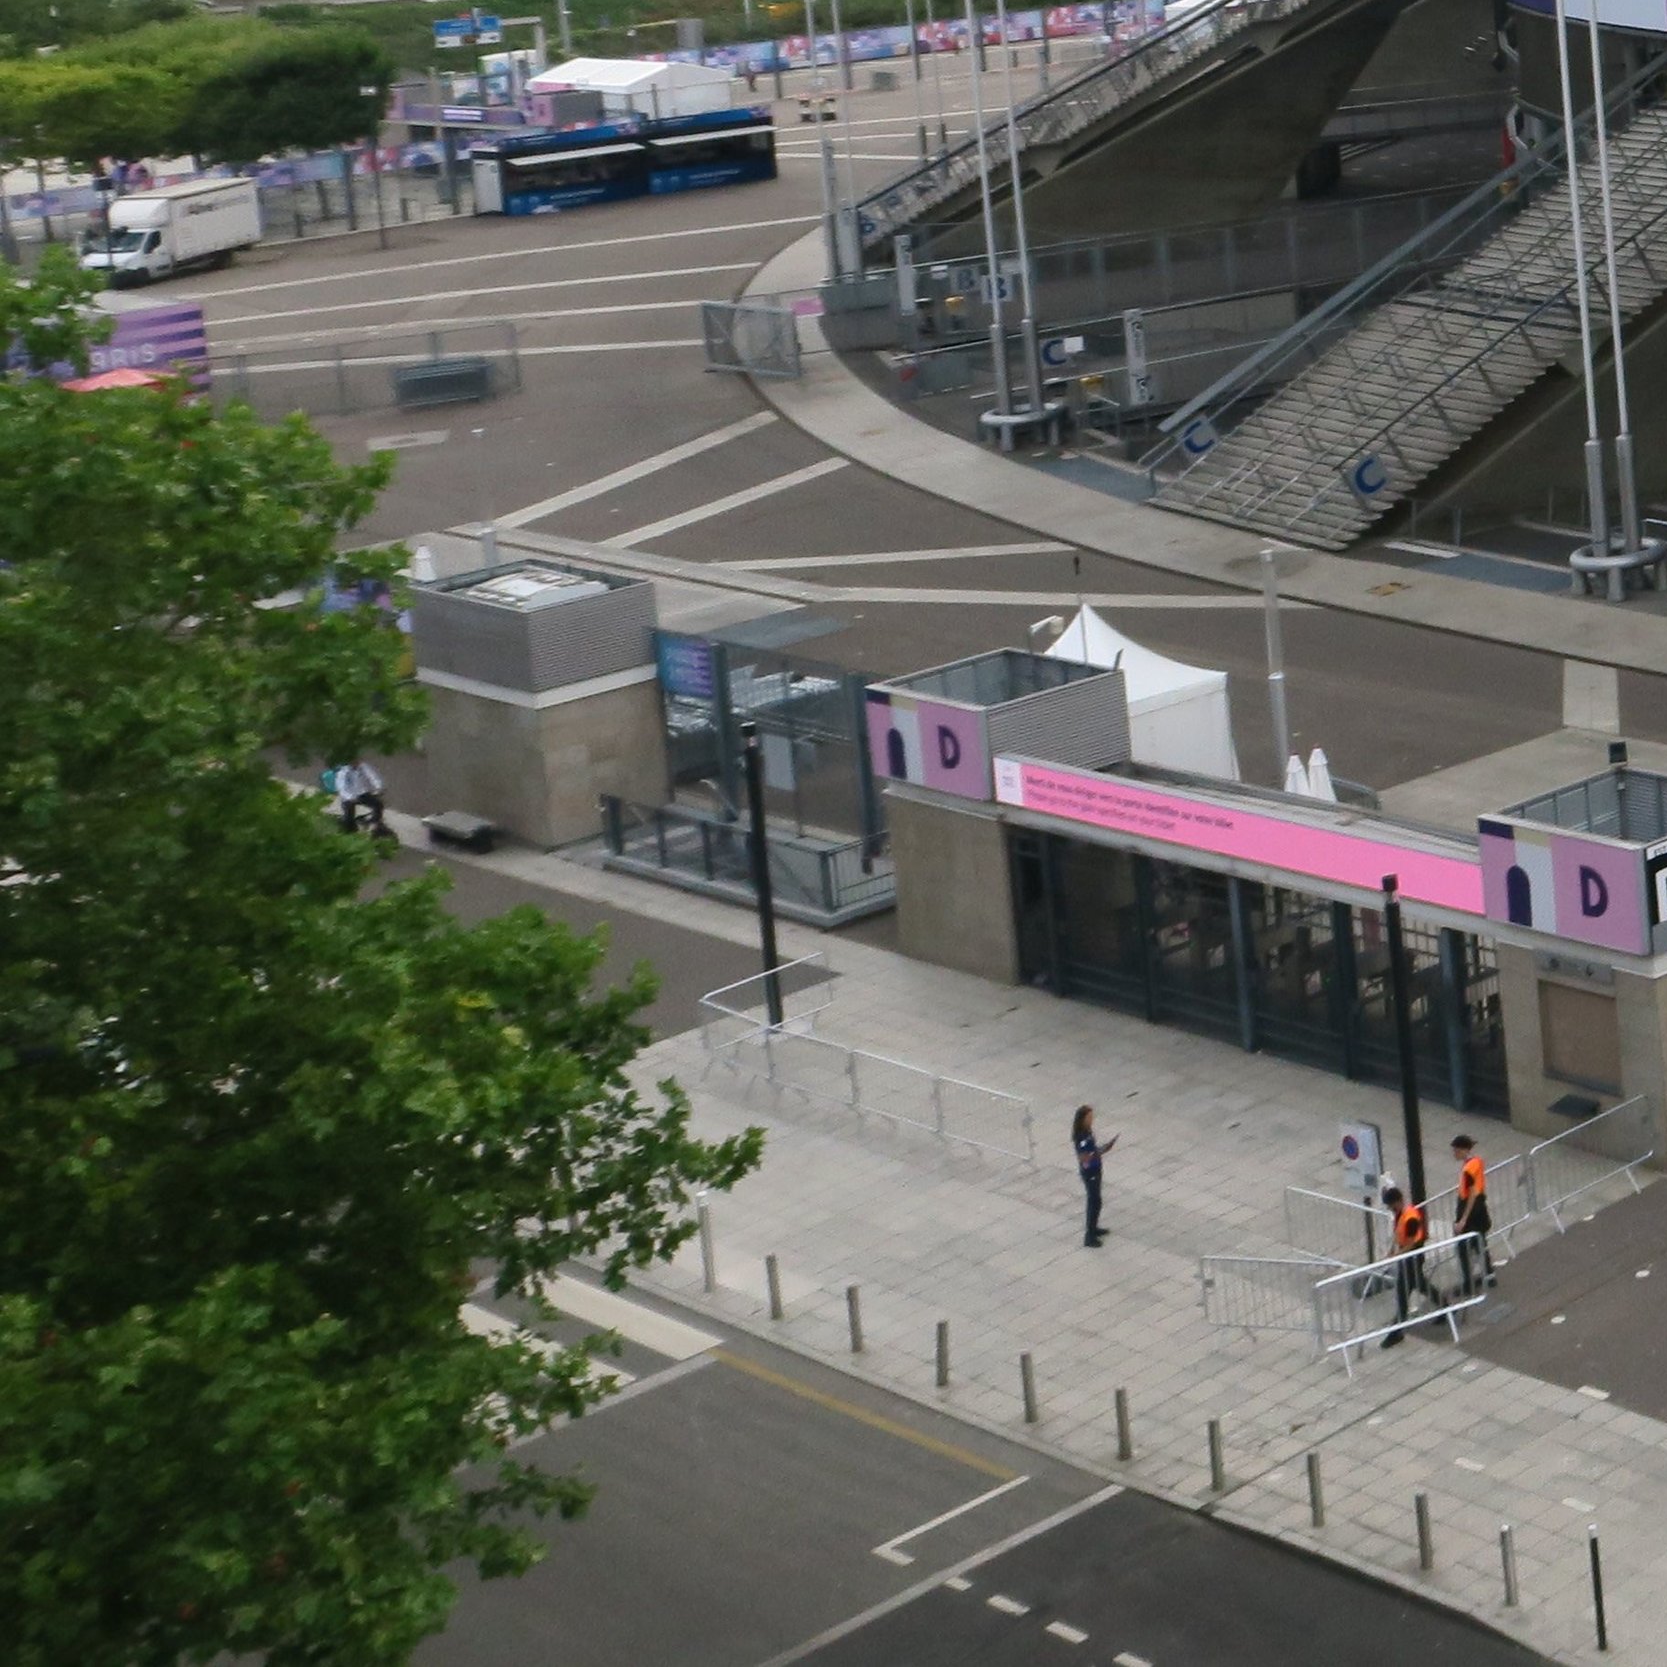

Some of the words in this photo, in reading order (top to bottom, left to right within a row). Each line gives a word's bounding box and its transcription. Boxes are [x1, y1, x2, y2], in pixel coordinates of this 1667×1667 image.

[1184, 421, 1216, 454] C
[1355, 457, 1386, 495] C
[937, 724, 961, 770] D
[1579, 864, 1608, 918] D
